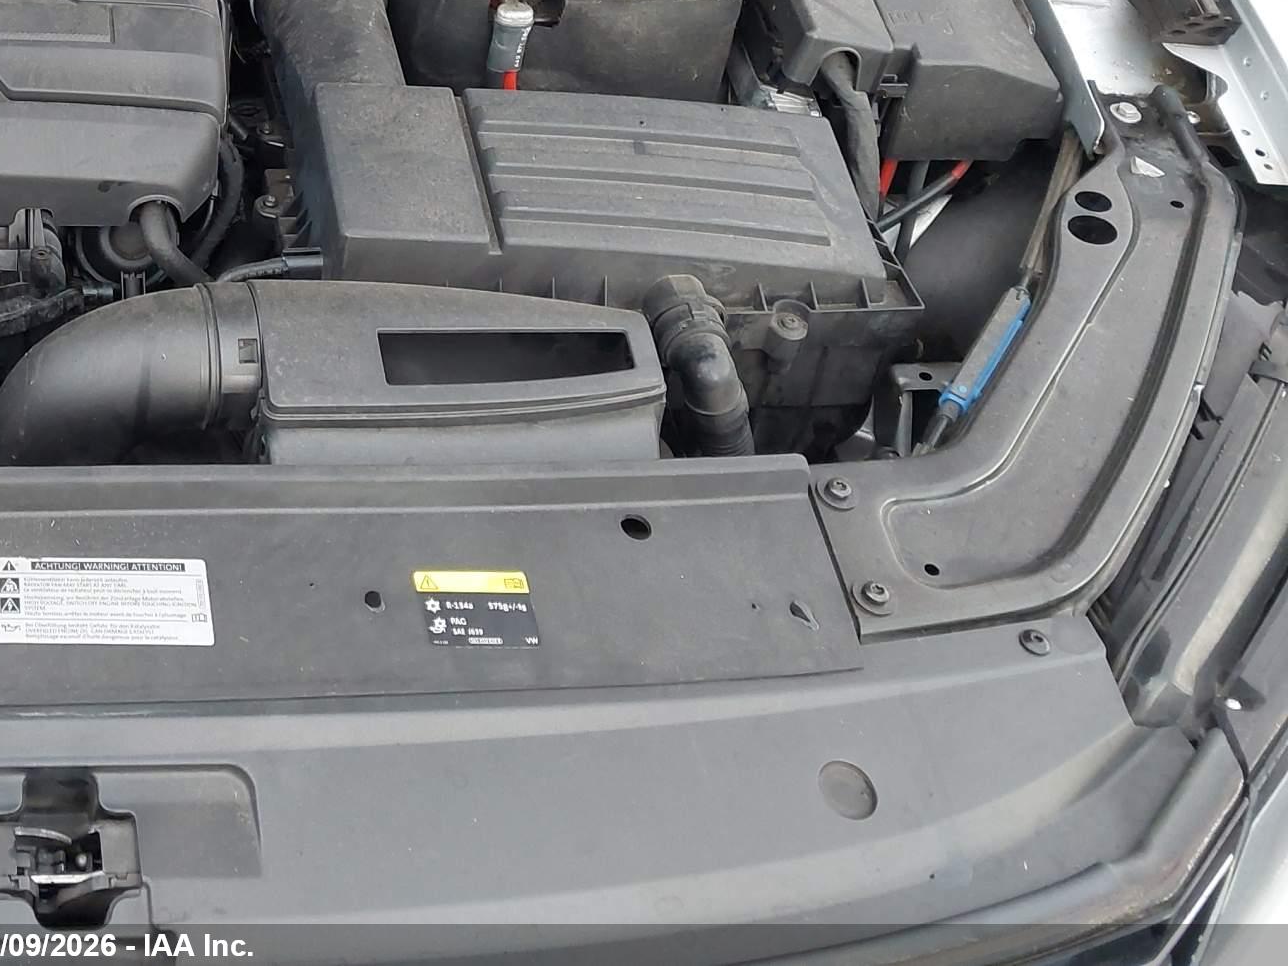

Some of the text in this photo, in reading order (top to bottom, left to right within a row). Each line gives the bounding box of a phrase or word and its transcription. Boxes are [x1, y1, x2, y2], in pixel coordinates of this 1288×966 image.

[34, 562, 182, 571] ACHTUNG! WARNING! ATTENTION!
[524, 637, 539, 645] VW
